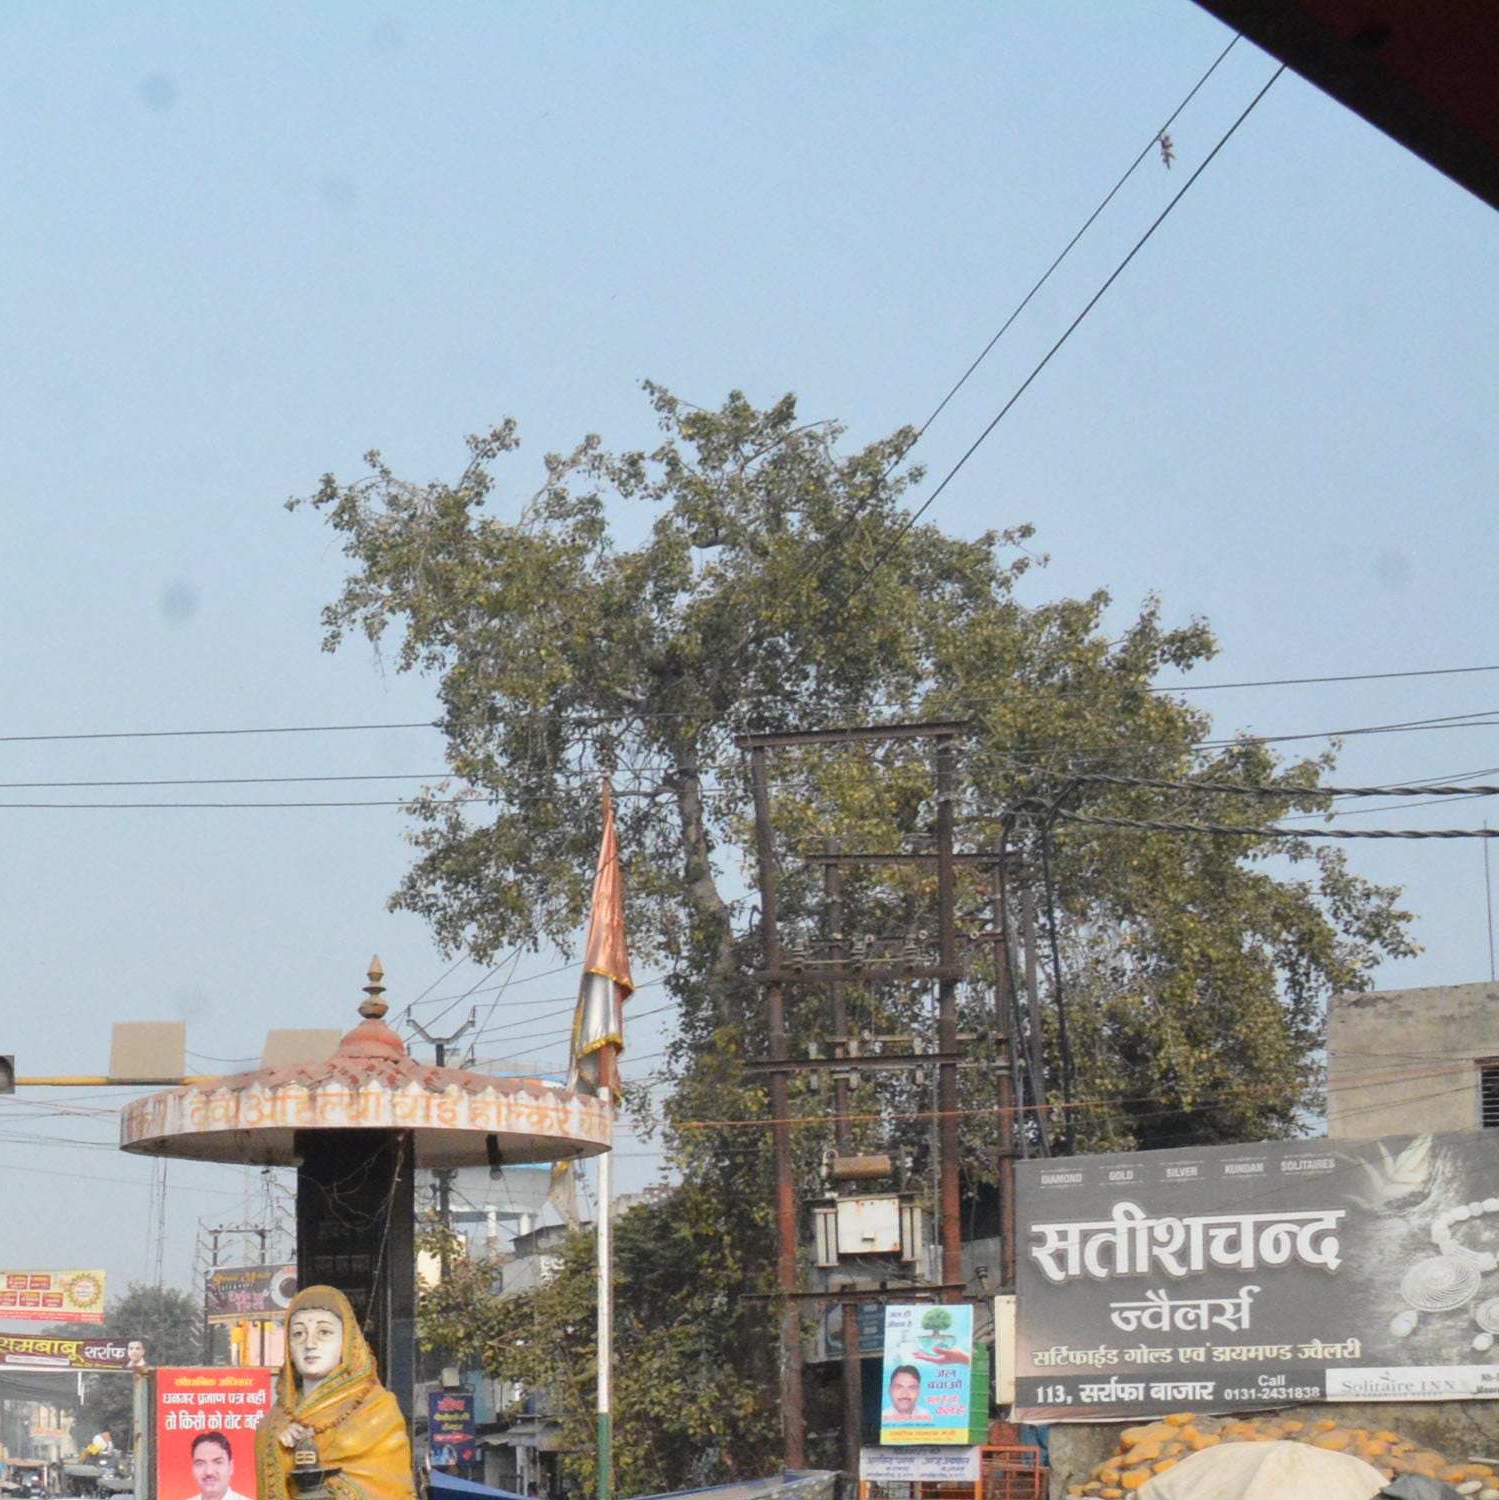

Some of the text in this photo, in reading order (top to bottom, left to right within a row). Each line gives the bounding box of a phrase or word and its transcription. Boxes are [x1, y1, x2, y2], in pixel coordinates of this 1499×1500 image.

[1040, 1157, 1336, 1185] DIAMOND GOLD SILVER KUNDAN SOLITAIRES
[1031, 1202, 1347, 1282] सतीशचन्द
[1110, 1285, 1262, 1333] ज्वैलर्स
[1033, 1344, 1118, 1369] सर्टिफाईड
[1124, 1341, 1173, 1365] गोल्ड
[1212, 1342, 1292, 1363] डायमण्ड
[1297, 1337, 1361, 1360] ज्वैलरी
[1079, 1378, 1145, 1403] सर्राफा
[1149, 1380, 1216, 1402] बाजार
[1258, 1373, 1286, 1388] Call
[1341, 1379, 1417, 1394] Solitaire
[1223, 1385, 1321, 1402] 0131-2431838
[165, 1411, 177, 1431] तो
[179, 1409, 205, 1431] किसी
[208, 1411, 222, 1430] को
